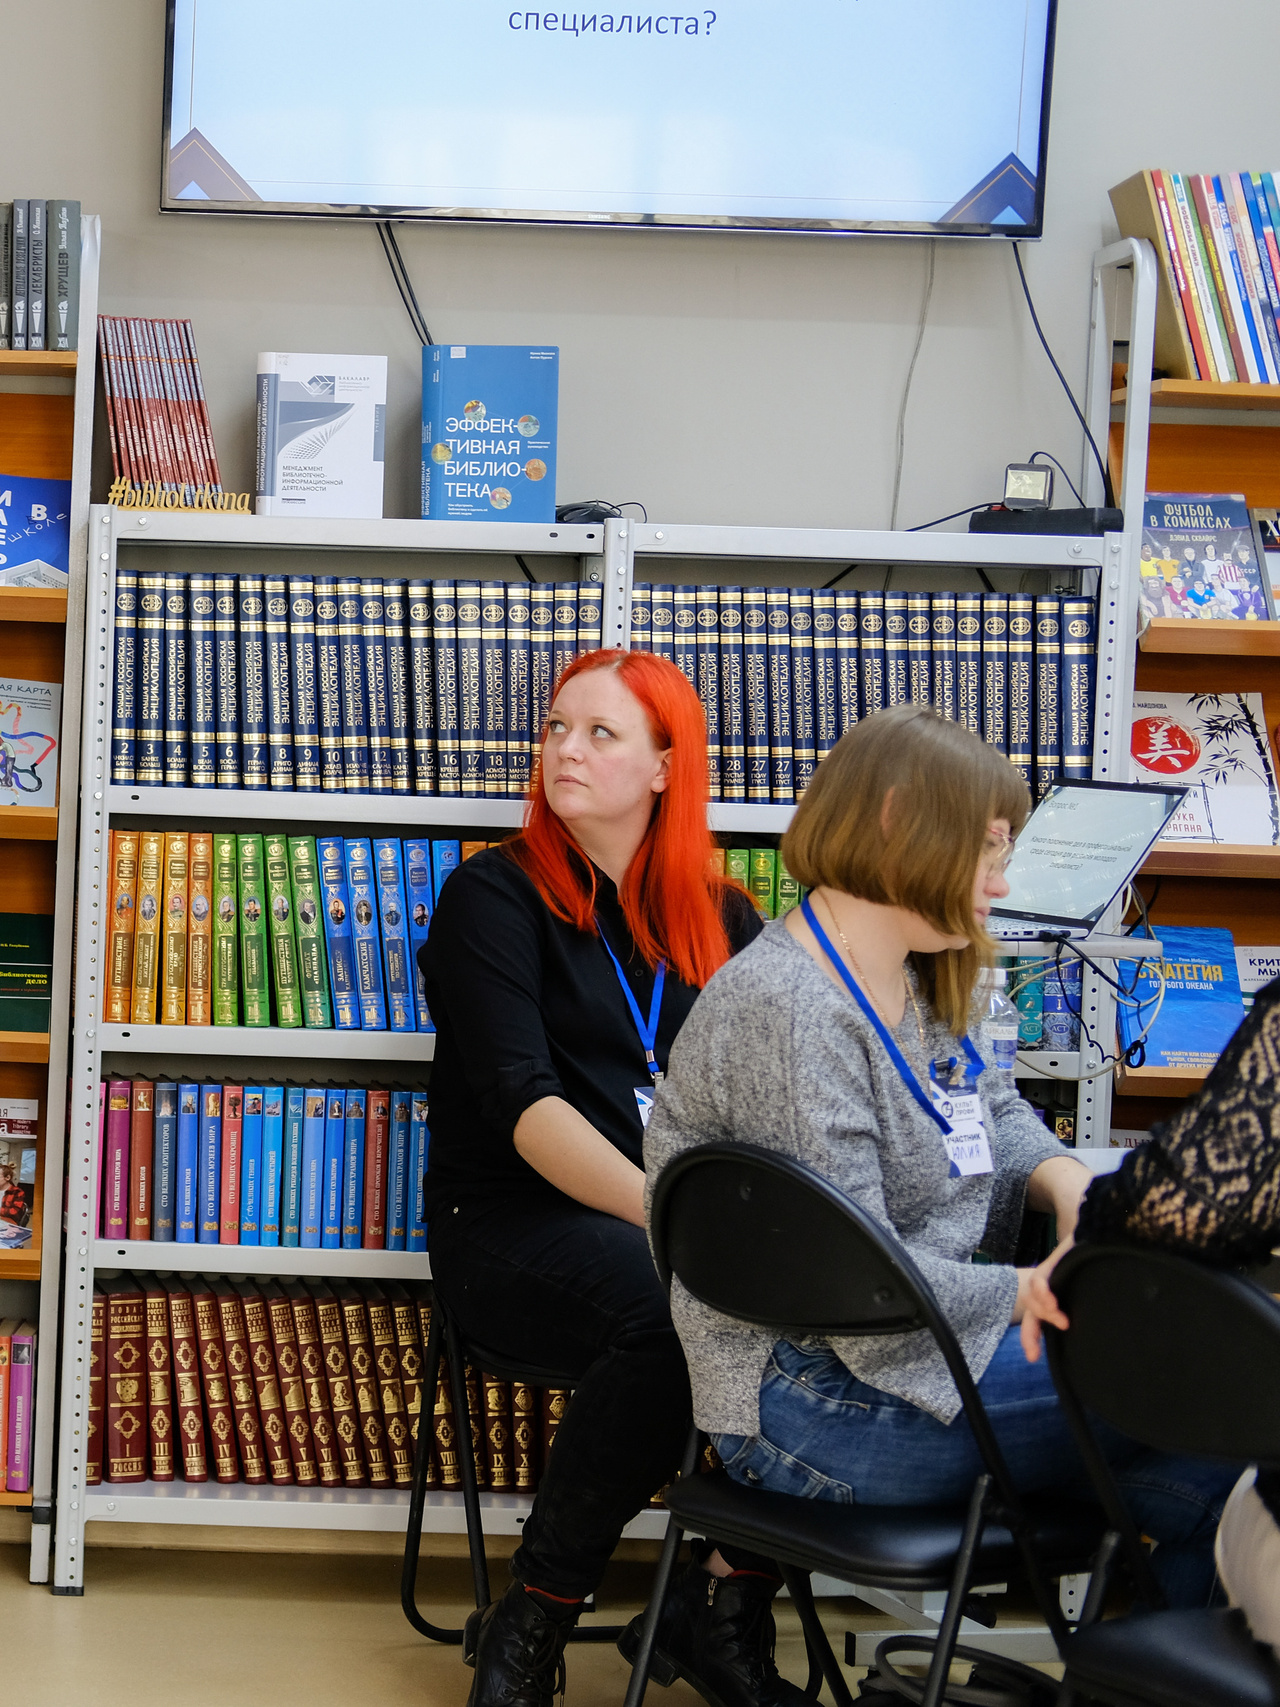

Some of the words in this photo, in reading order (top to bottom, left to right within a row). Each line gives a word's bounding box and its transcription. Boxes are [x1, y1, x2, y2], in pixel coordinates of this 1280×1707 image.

[509, 6, 718, 38] специалиста?
[32, 239, 43, 294] ДЕКАБРИСТЫ
[58, 252, 69, 297] ХРУЩЕВ
[445, 417, 519, 433] ЭФФЕК-
[445, 439, 520, 455] ТИВНАЯ
[444, 461, 527, 477] БИБЛИО-
[444, 483, 491, 498] ТЕКА
[31, 503, 47, 521] В
[1164, 504, 1214, 517] ФУТБОЛ
[1150, 515, 1158, 527] В
[1163, 516, 1232, 529] КОМИКСАХ
[150, 638, 160, 720] ЭНЦИКЛОПЕДИЯ
[204, 640, 213, 722] ЭНЦИКЛОПЕДИЯ
[16, 686, 52, 696] КАРТА
[1080, 663, 1089, 746] ЭНЦИКЛОПЕДИЯ
[146, 743, 154, 755] 3
[202, 746, 208, 757] 5
[252, 748, 260, 759] 7
[442, 754, 457, 765] 16
[466, 754, 481, 765] 17
[489, 755, 503, 766] 18
[512, 755, 526, 766] 19
[726, 760, 741, 772] 28
[751, 761, 766, 772] 27
[1041, 769, 1055, 781] 31
[1186, 982, 1214, 990] ОКЕАНА
[1023, 1024, 1039, 1033] АСТ
[1052, 1024, 1068, 1033] АСТ
[946, 1133, 981, 1143] УЧАСТНИК
